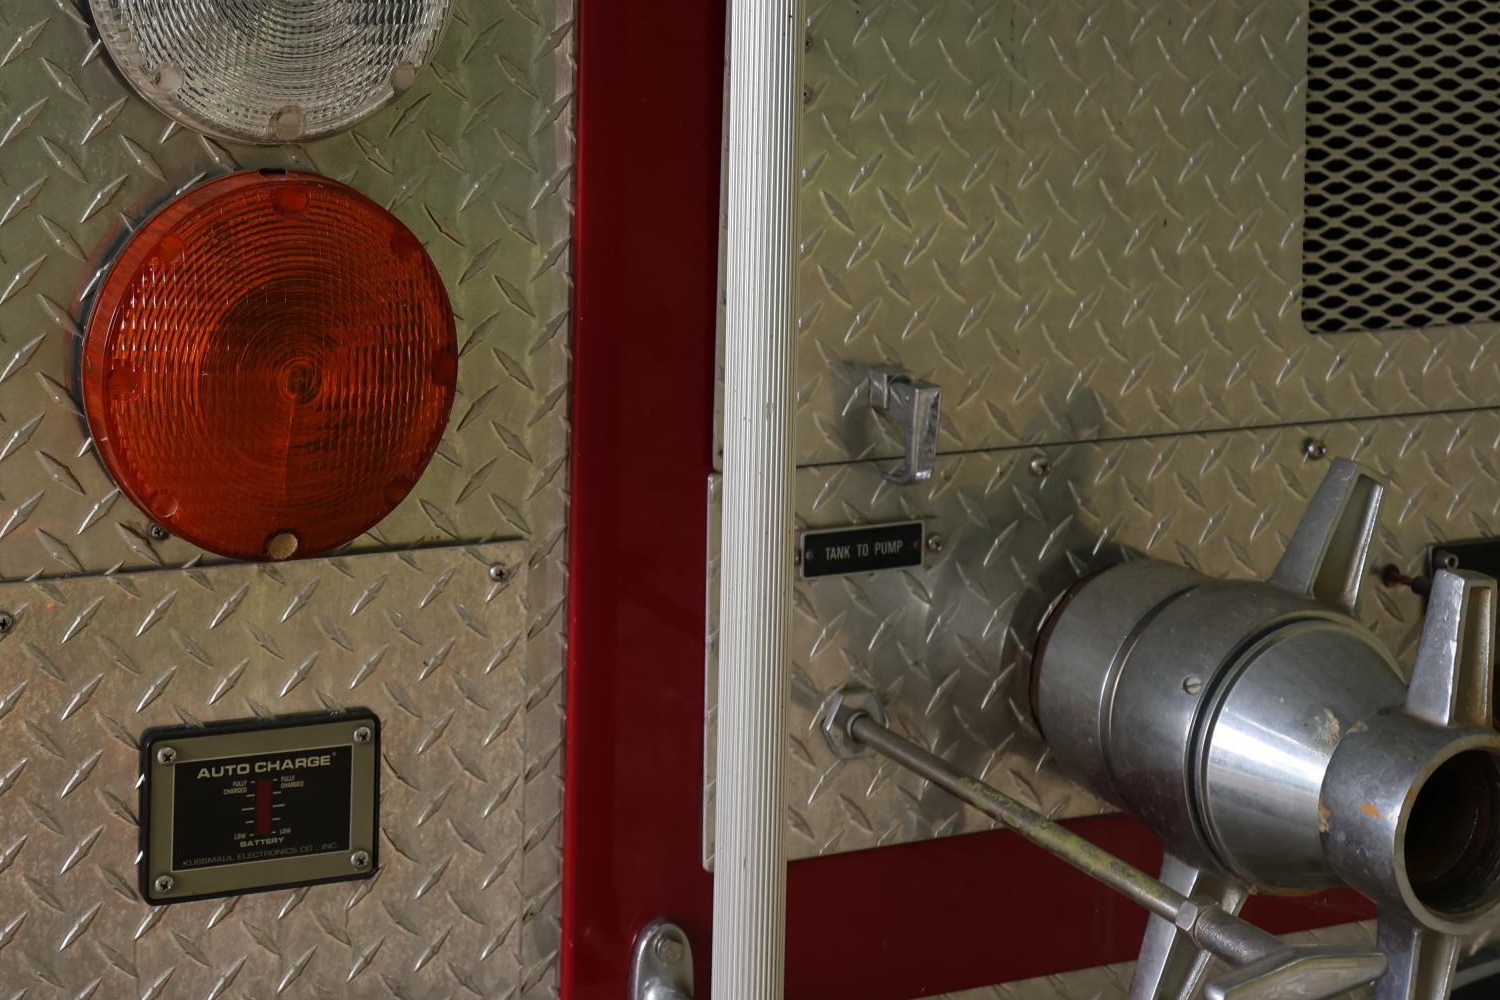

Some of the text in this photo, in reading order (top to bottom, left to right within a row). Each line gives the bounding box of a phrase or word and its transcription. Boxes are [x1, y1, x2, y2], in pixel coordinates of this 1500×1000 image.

[825, 540, 904, 560] TANK TO PUMP
[197, 756, 331, 779] AUTO CHARGE
[232, 780, 248, 788] FULLY
[281, 780, 304, 788] CHARGED
[224, 786, 248, 795] CHARGED
[240, 836, 284, 848] BATTERY
[237, 846, 298, 861] ELECTRONICS
